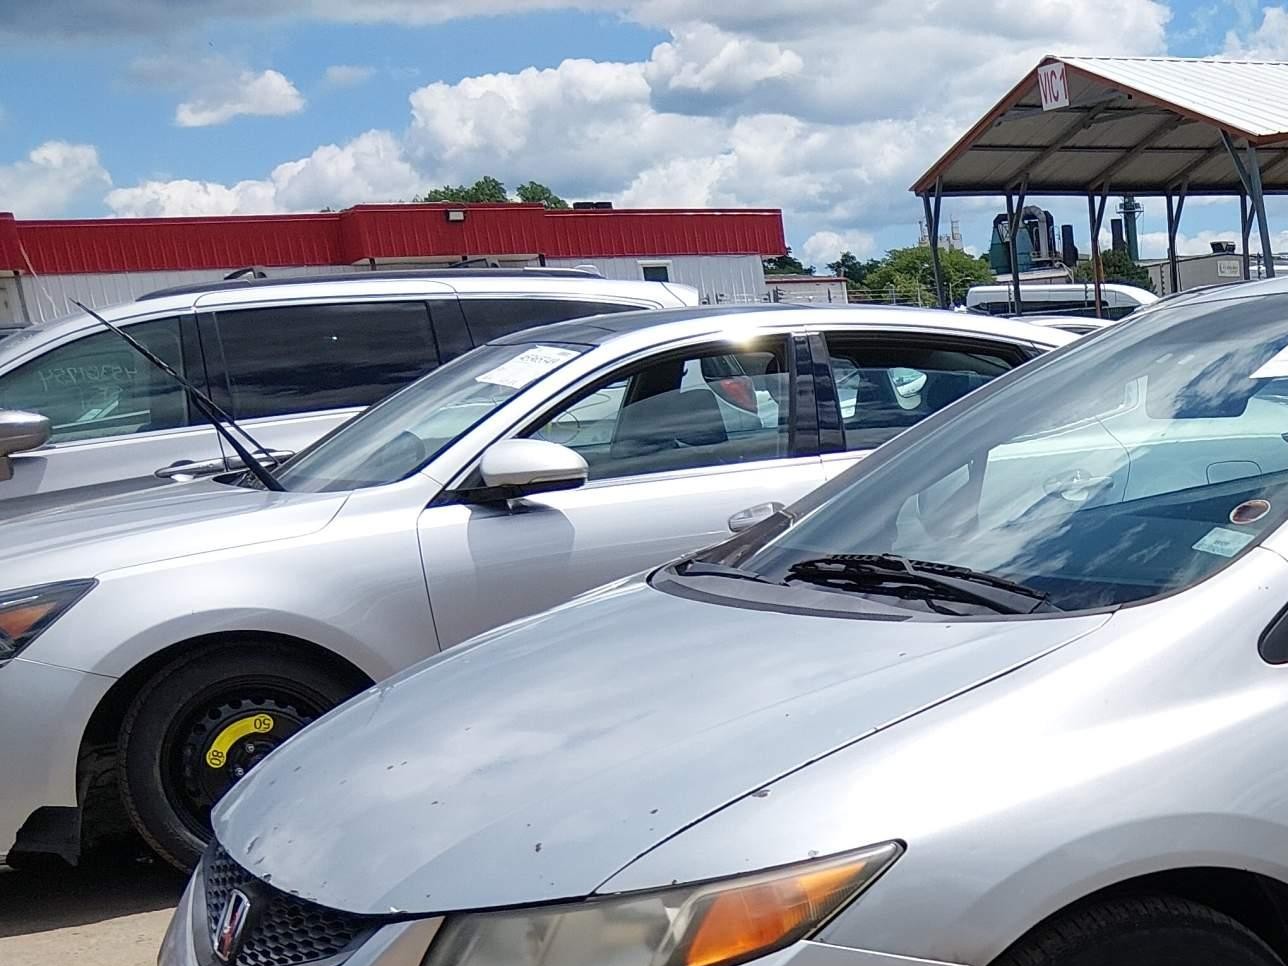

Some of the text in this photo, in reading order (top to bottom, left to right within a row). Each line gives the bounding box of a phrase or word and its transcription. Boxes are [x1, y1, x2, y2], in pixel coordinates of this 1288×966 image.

[1039, 67, 1068, 105] VIC 1
[254, 718, 272, 730] 50
[210, 749, 224, 766] 80
